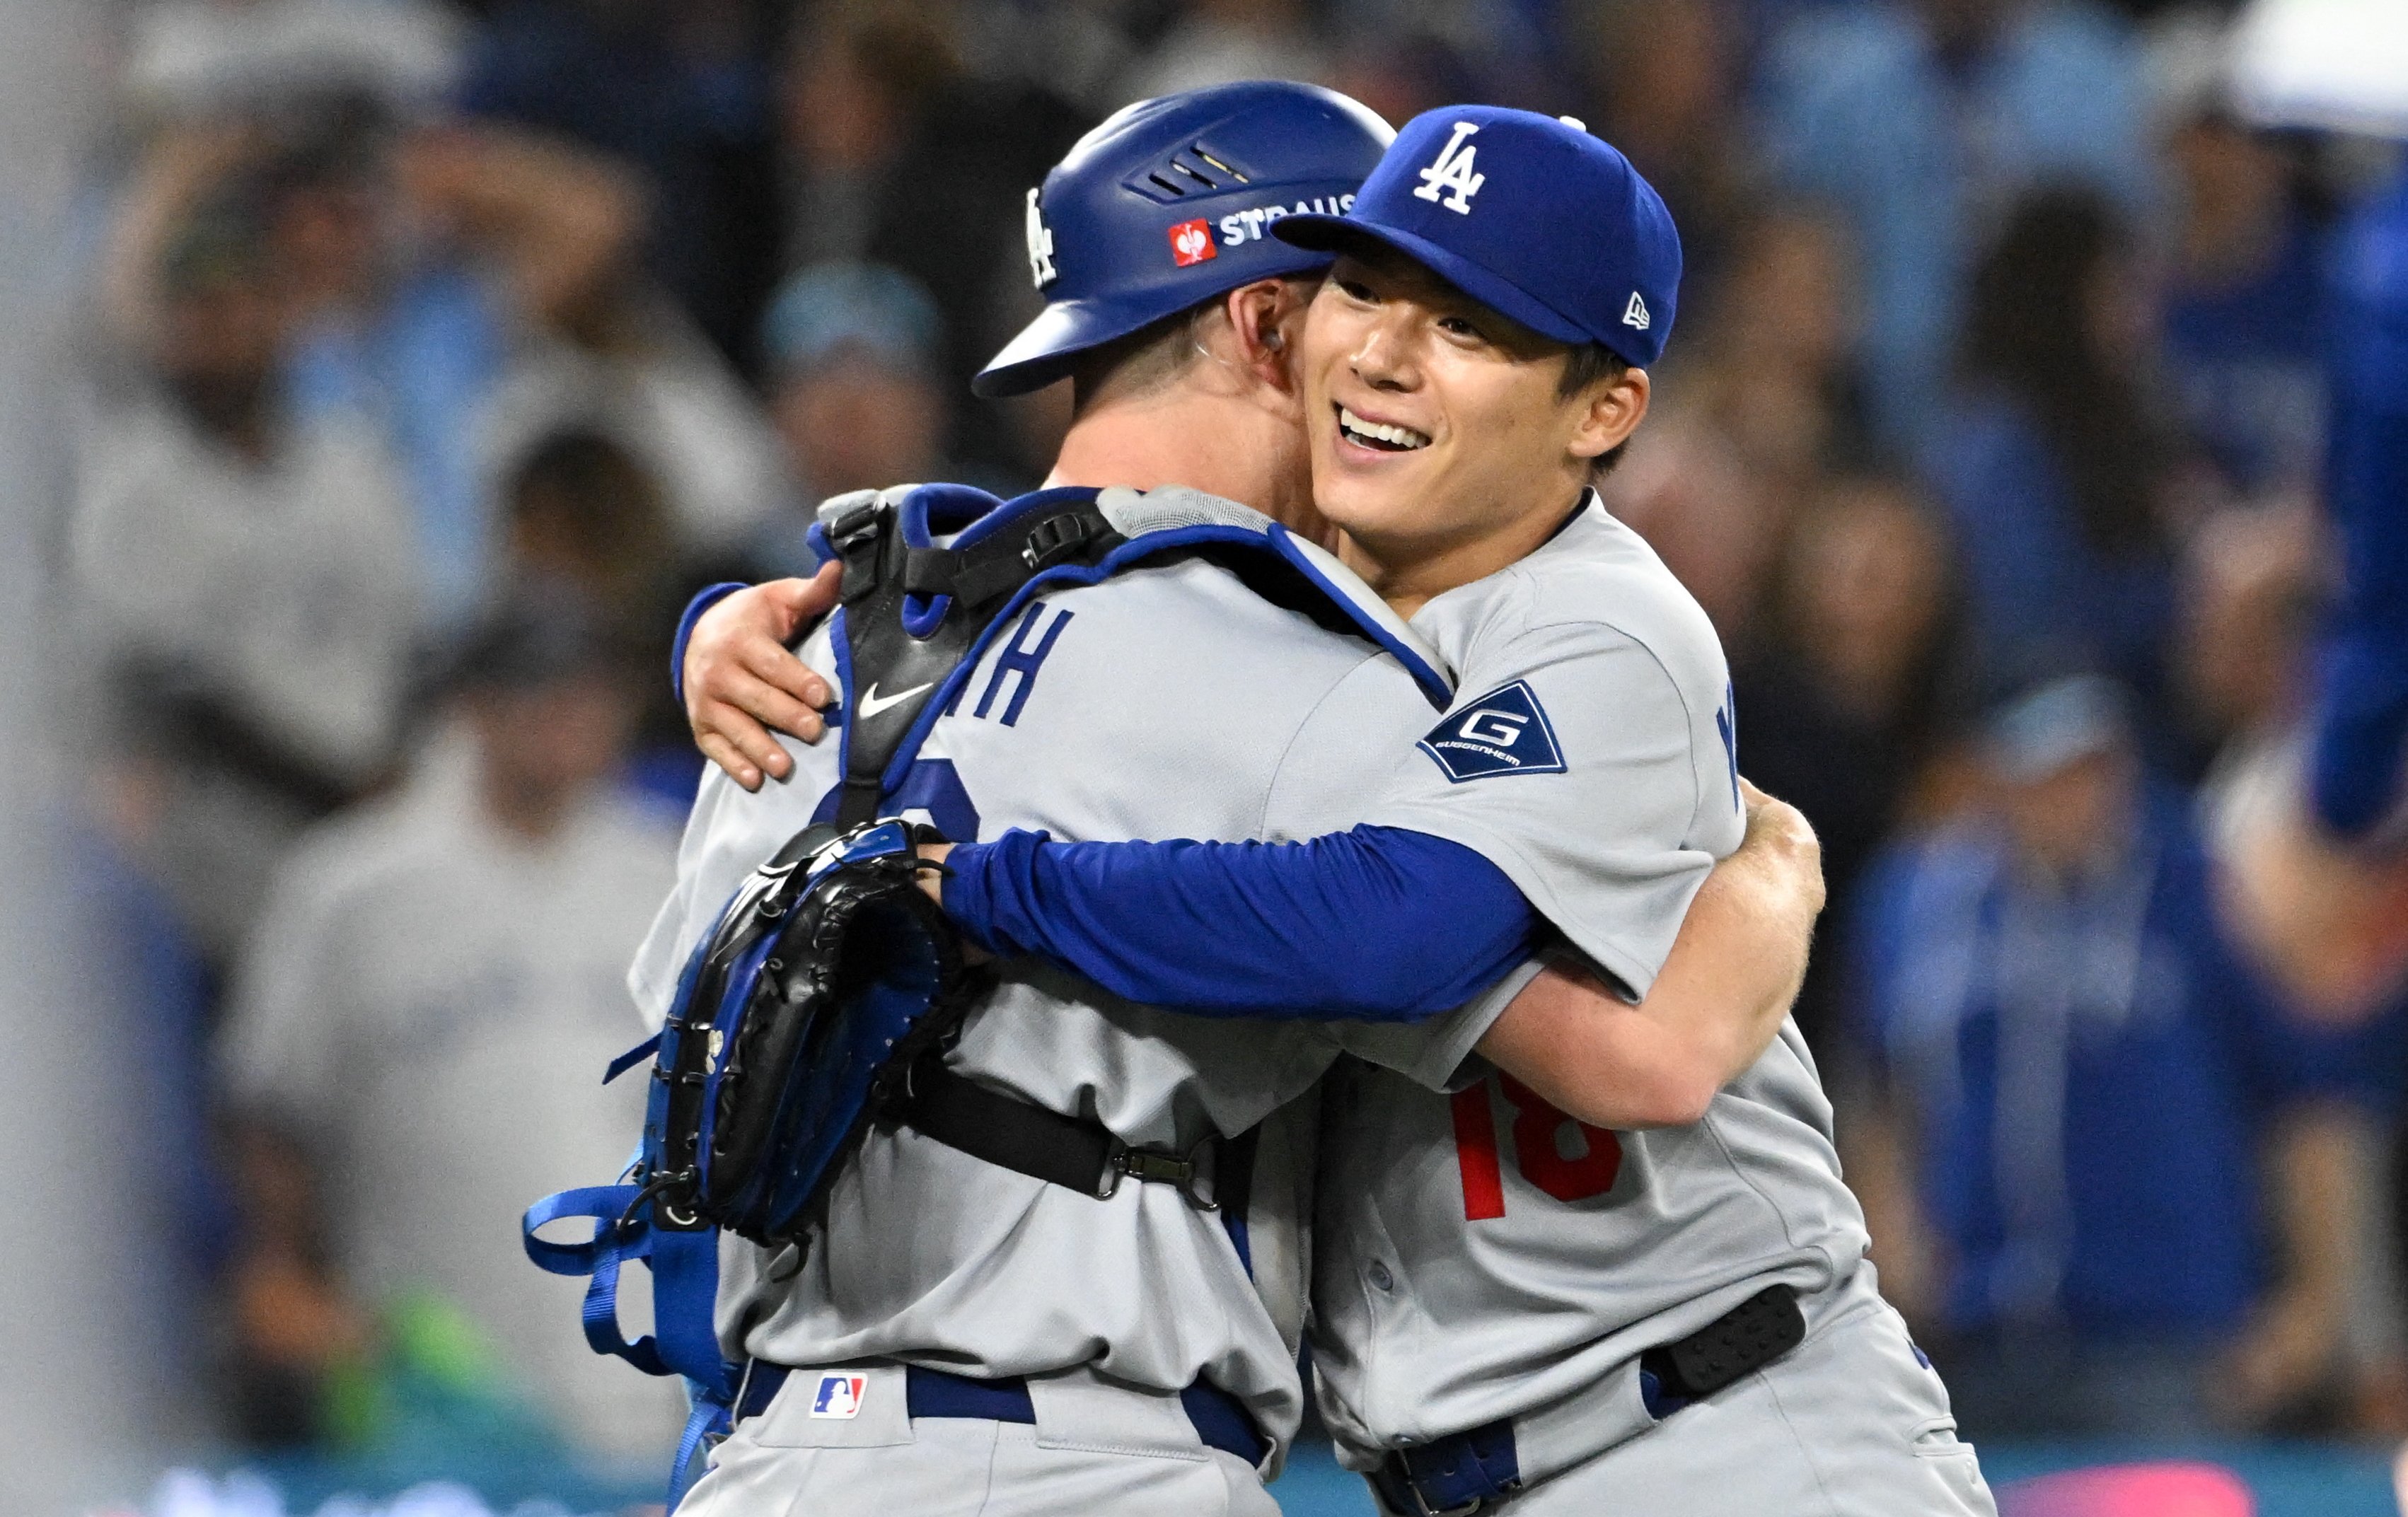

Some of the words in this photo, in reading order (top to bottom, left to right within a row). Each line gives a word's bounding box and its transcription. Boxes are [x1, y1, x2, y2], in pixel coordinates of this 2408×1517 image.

[1414, 122, 1485, 215] LA
[1459, 709, 1529, 747] G
[1435, 741, 1520, 766] GUGGENHEIM
